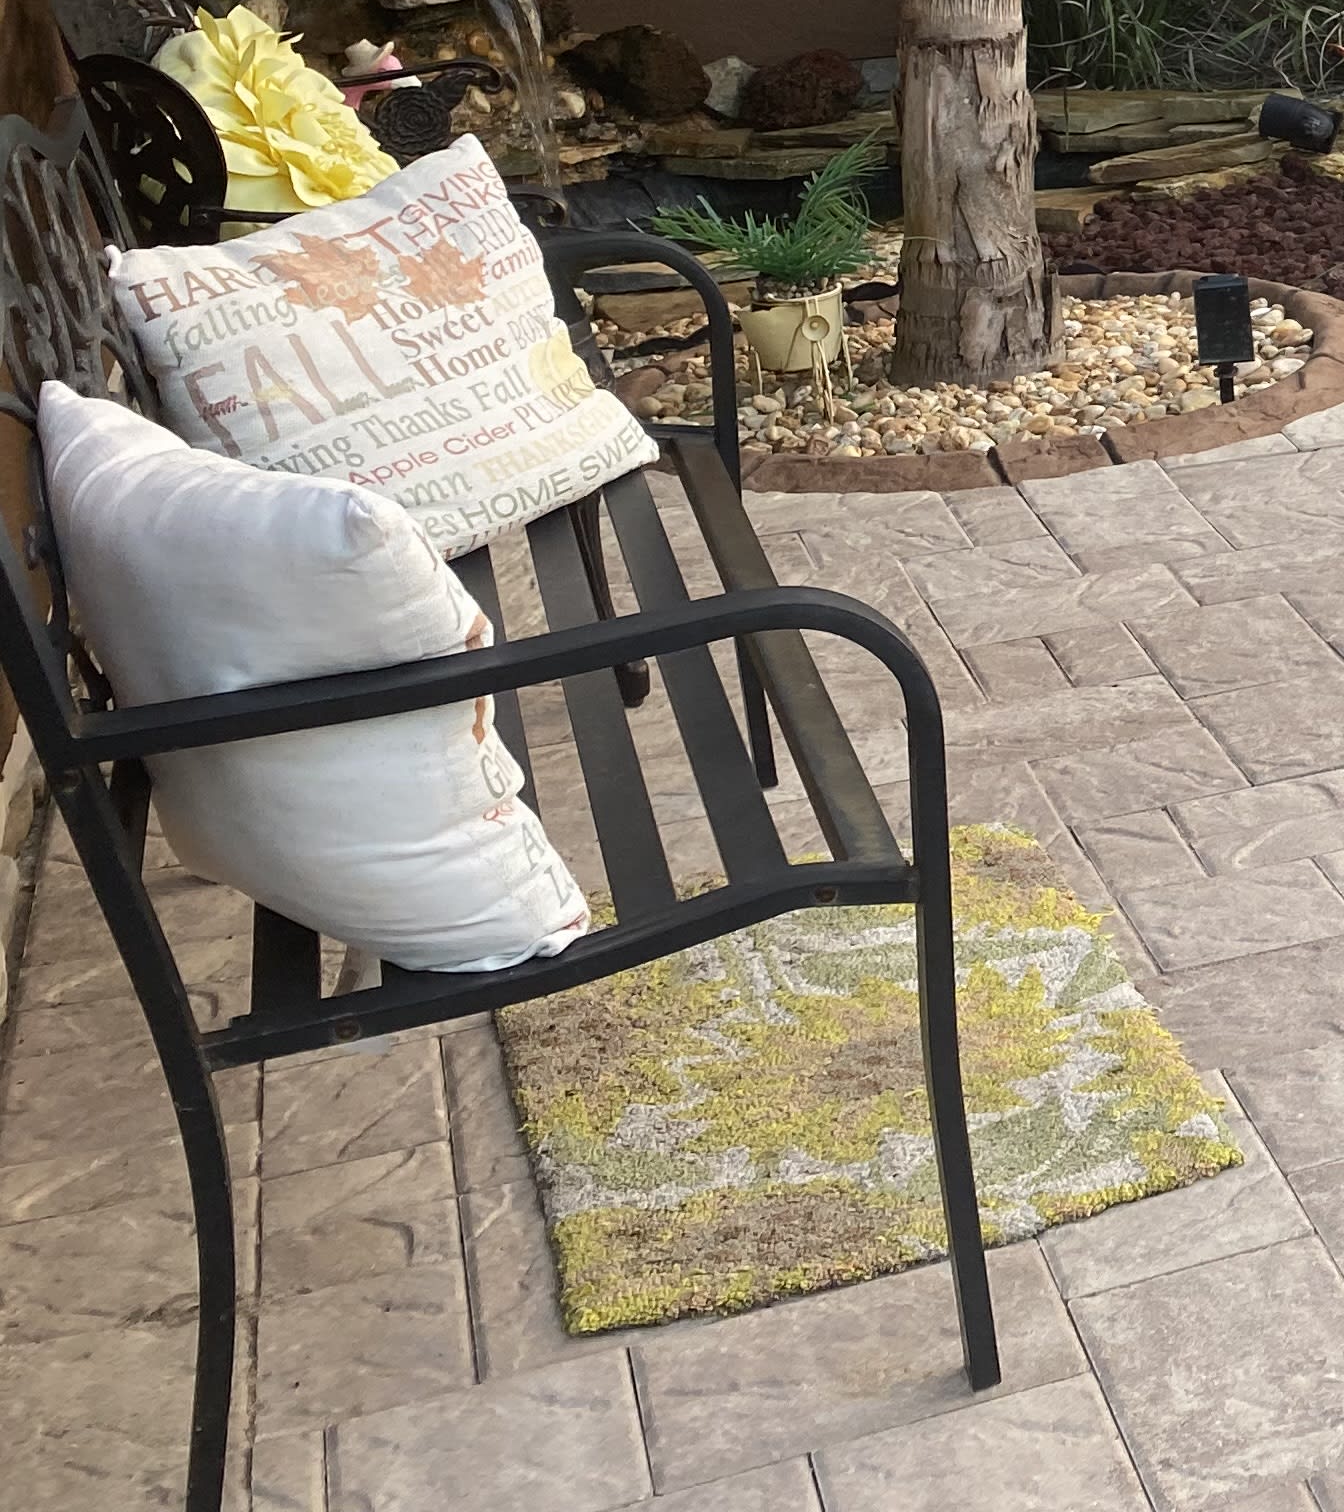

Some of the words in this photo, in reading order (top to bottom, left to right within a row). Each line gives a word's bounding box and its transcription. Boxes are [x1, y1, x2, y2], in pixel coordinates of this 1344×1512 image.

[397, 160, 499, 226] GIVING
[163, 294, 299, 369] falling
[390, 305, 495, 361] Sweet
[408, 336, 511, 387] Home
[181, 319, 421, 460] FALL
[351, 395, 473, 449] Thanks
[471, 363, 532, 412] Fall
[348, 450, 440, 486] Apple
[442, 420, 518, 456] Cider
[458, 468, 573, 530] HOME
